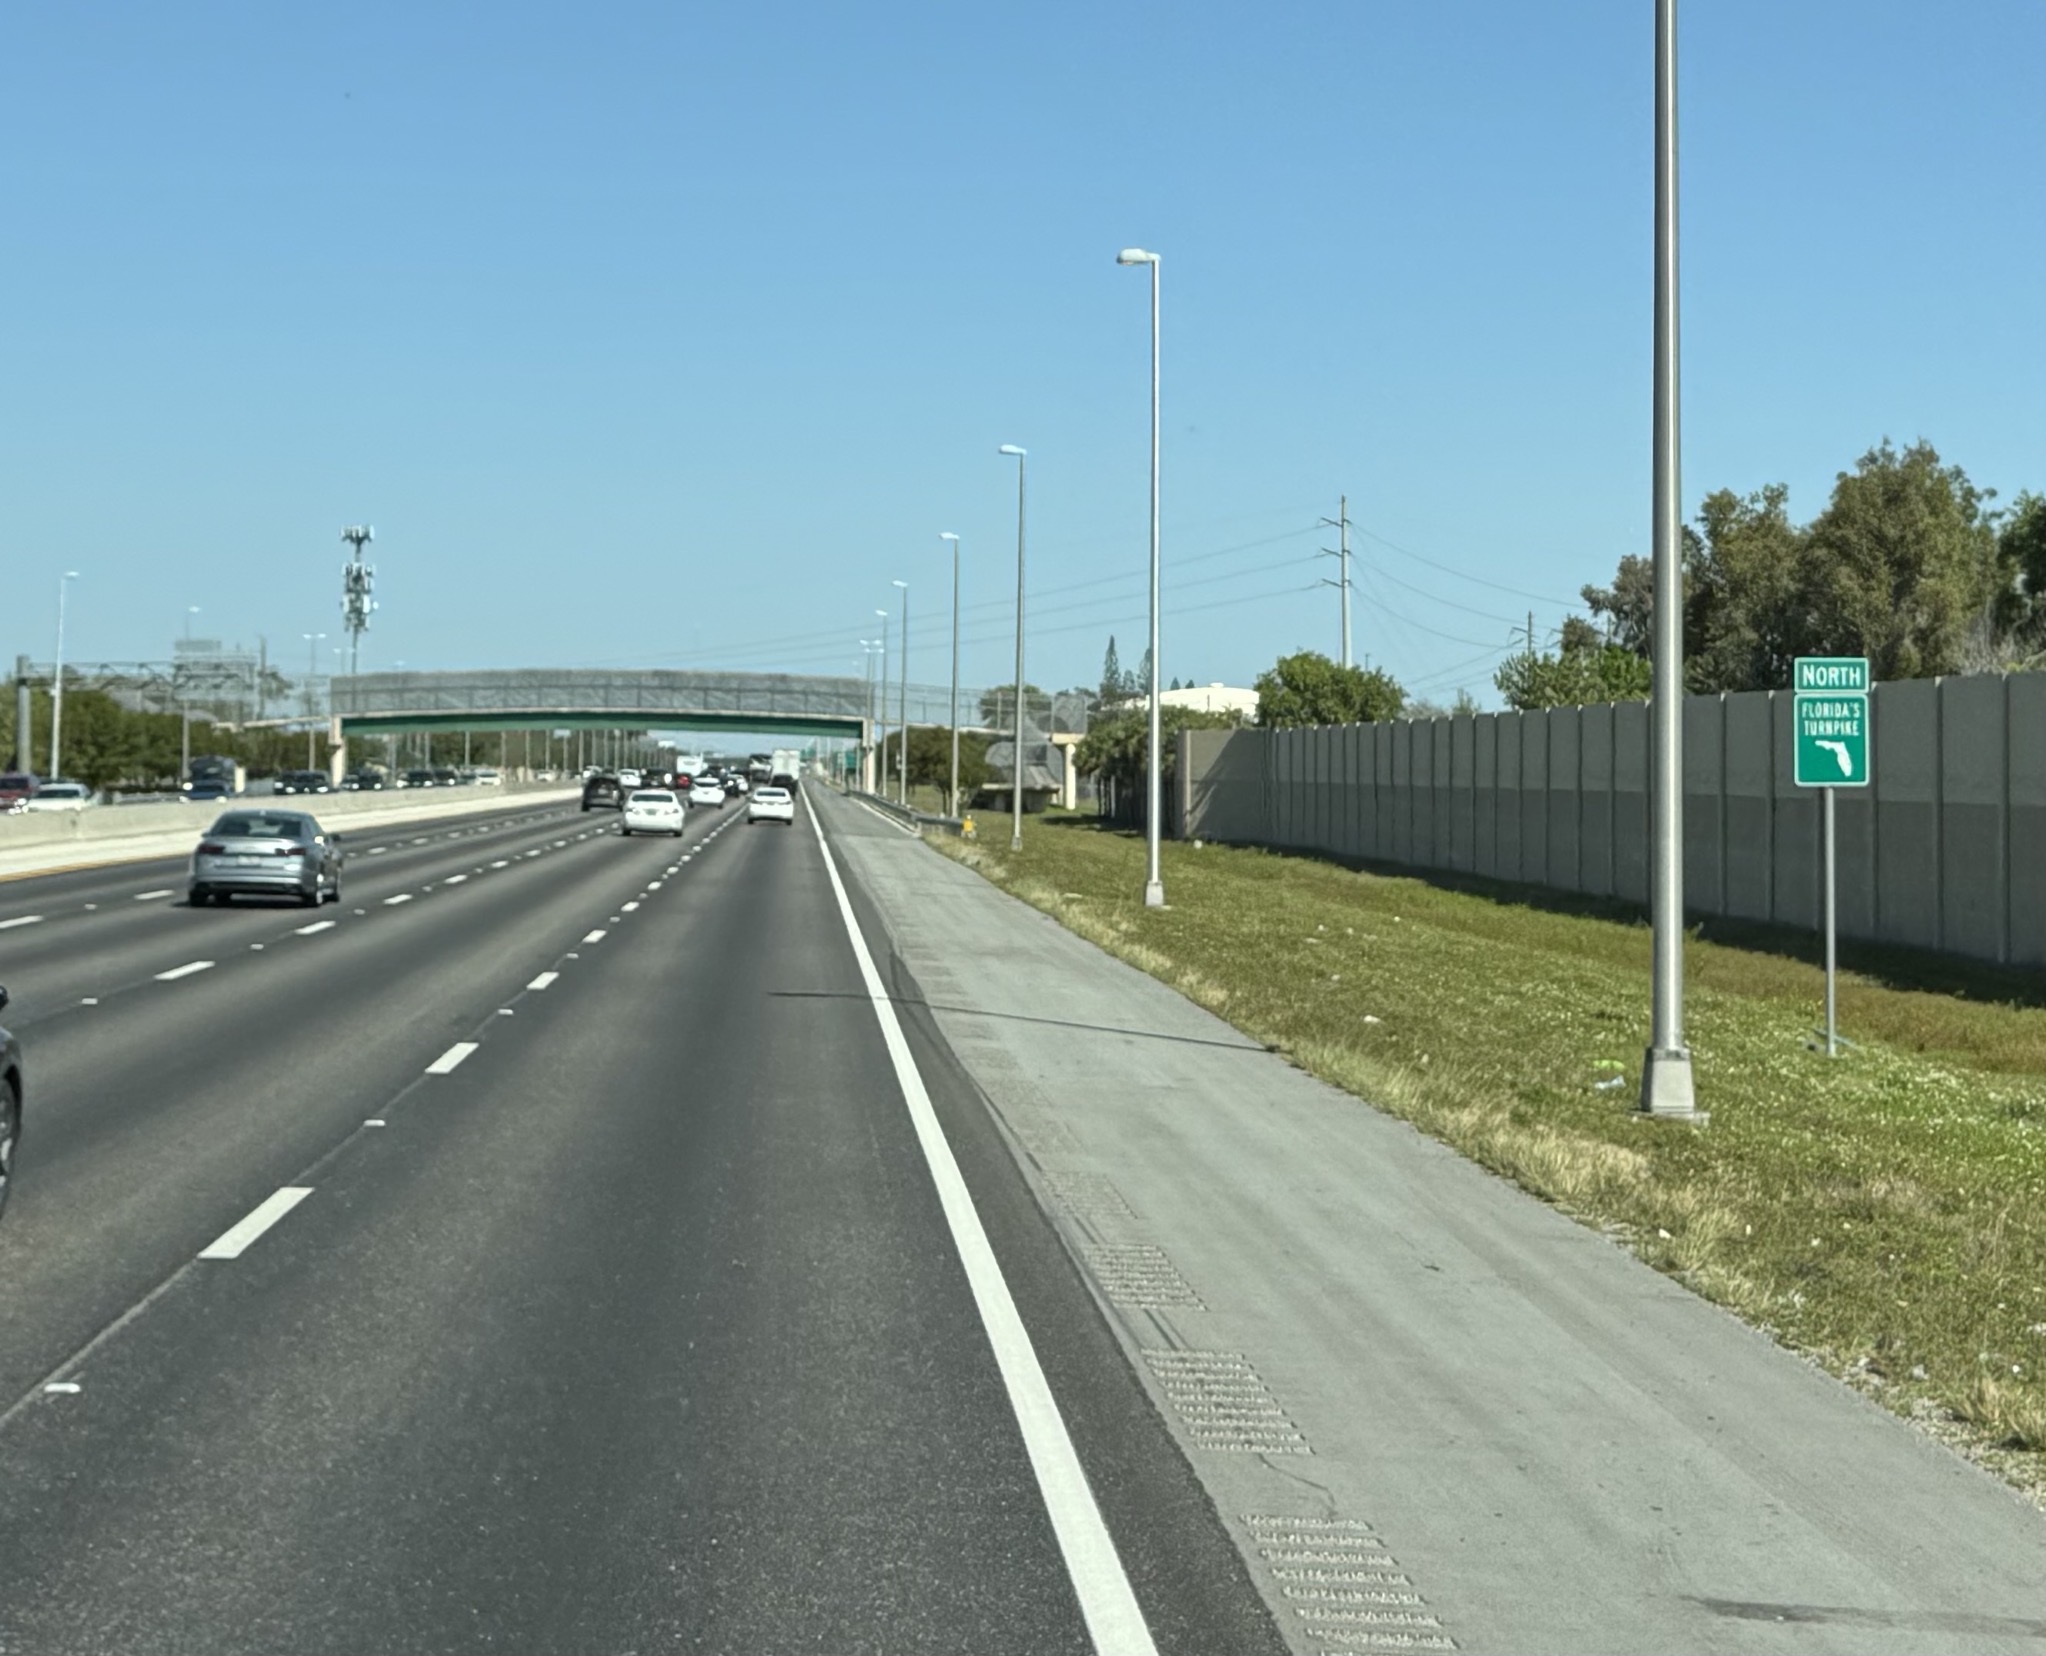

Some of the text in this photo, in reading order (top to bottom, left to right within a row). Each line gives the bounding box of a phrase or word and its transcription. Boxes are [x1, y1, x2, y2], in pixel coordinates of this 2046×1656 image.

[1802, 664, 1861, 686] NORTH
[1802, 701, 1860, 718] FLORIDA'S
[1804, 720, 1859, 736] TURNPIKE
